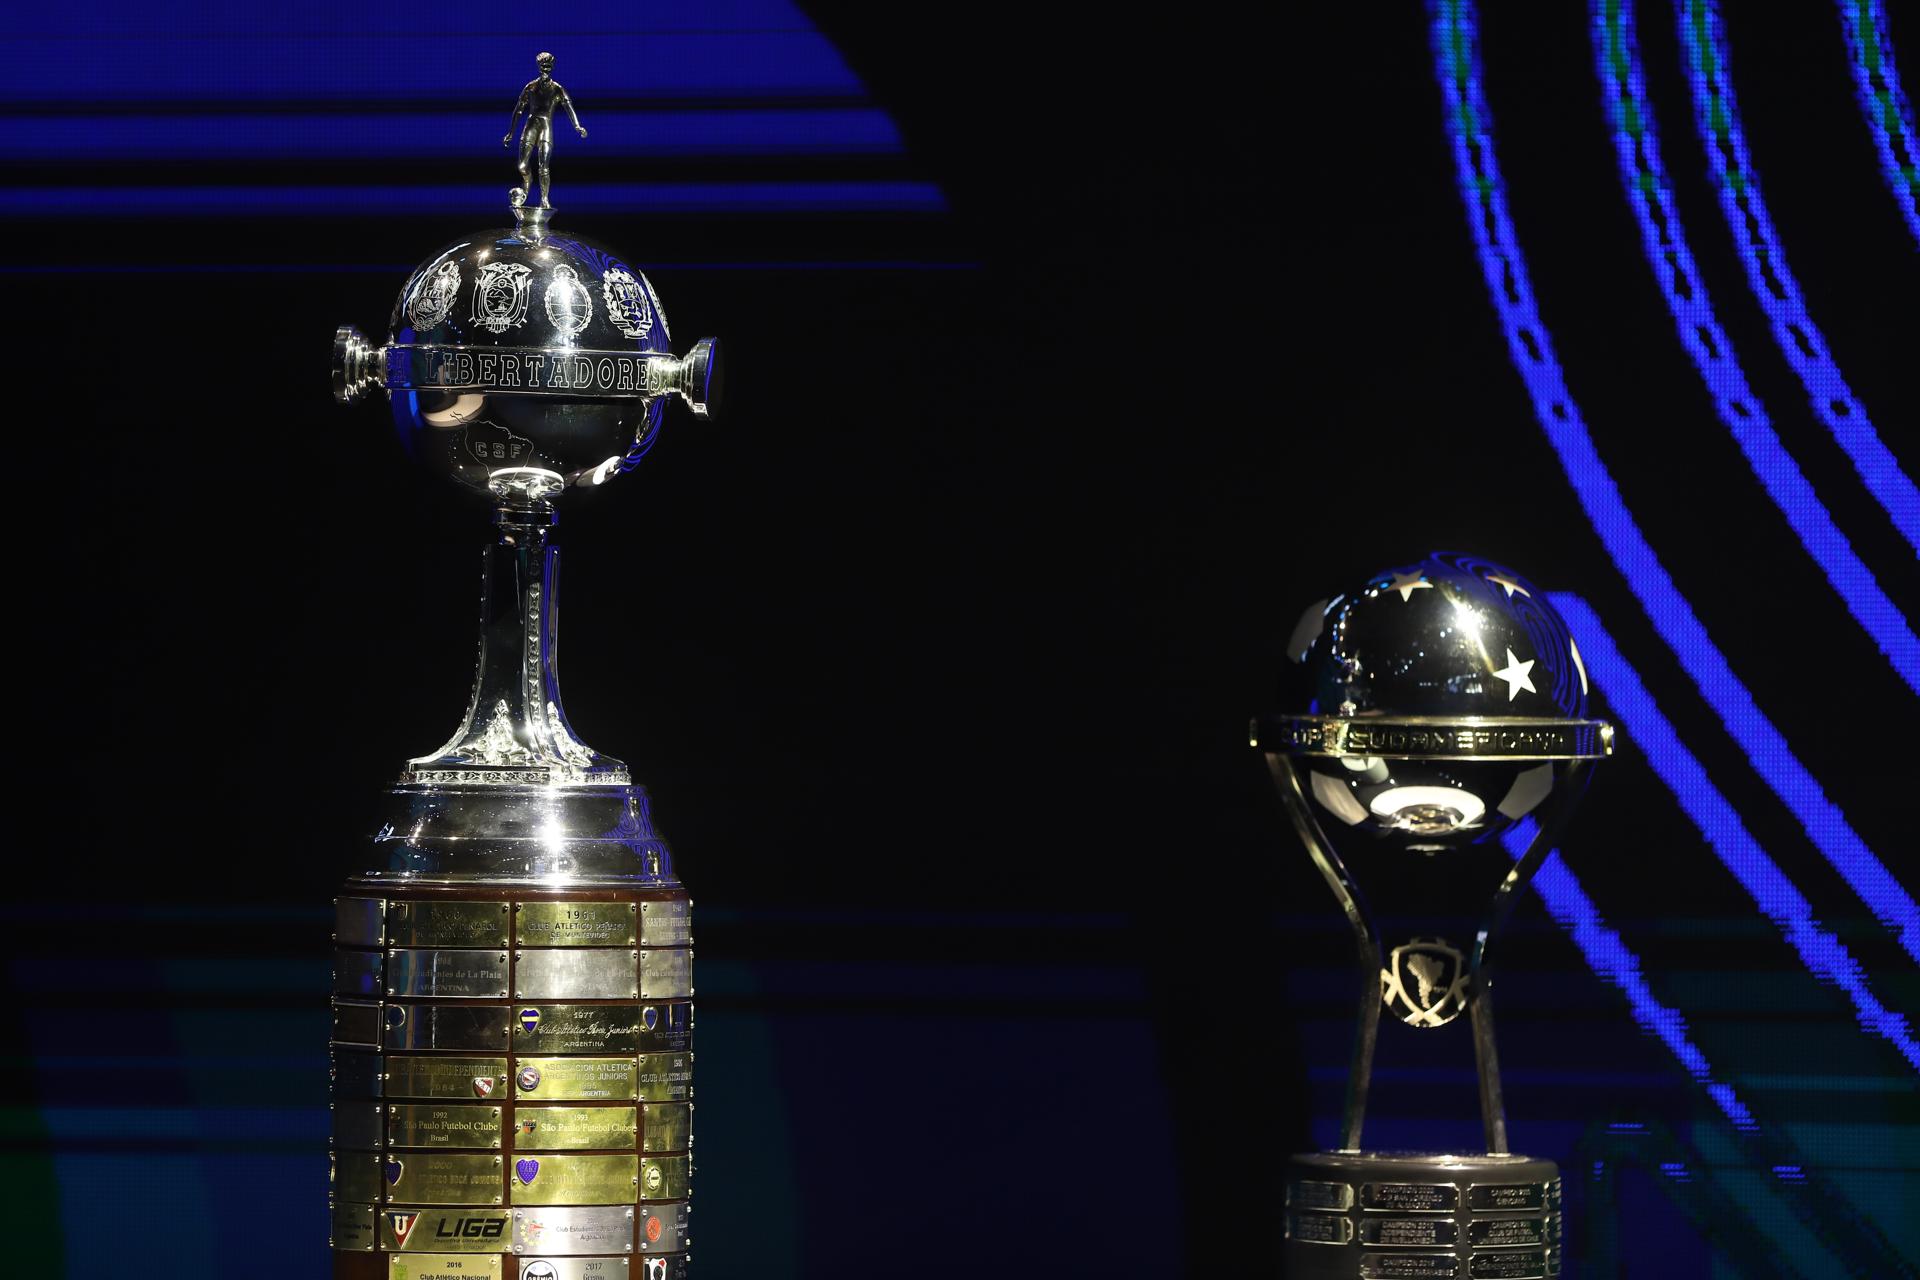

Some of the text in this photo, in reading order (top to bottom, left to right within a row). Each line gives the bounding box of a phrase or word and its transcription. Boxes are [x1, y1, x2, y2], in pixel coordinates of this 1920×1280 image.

[425, 352, 662, 391] LIBERTADORES
[596, 1063, 632, 1072] ATLETICA
[597, 1072, 628, 1081] JUNIORS
[433, 1111, 448, 1119] 1992
[574, 1113, 588, 1121] 1993
[418, 1121, 439, 1130] Paulo
[441, 1121, 471, 1130] Futebol
[474, 1121, 498, 1131] Clube
[558, 1123, 580, 1132] Paulo
[582, 1122, 609, 1132] Futebol
[430, 1134, 449, 1142] Brasil
[393, 1215, 409, 1236] U
